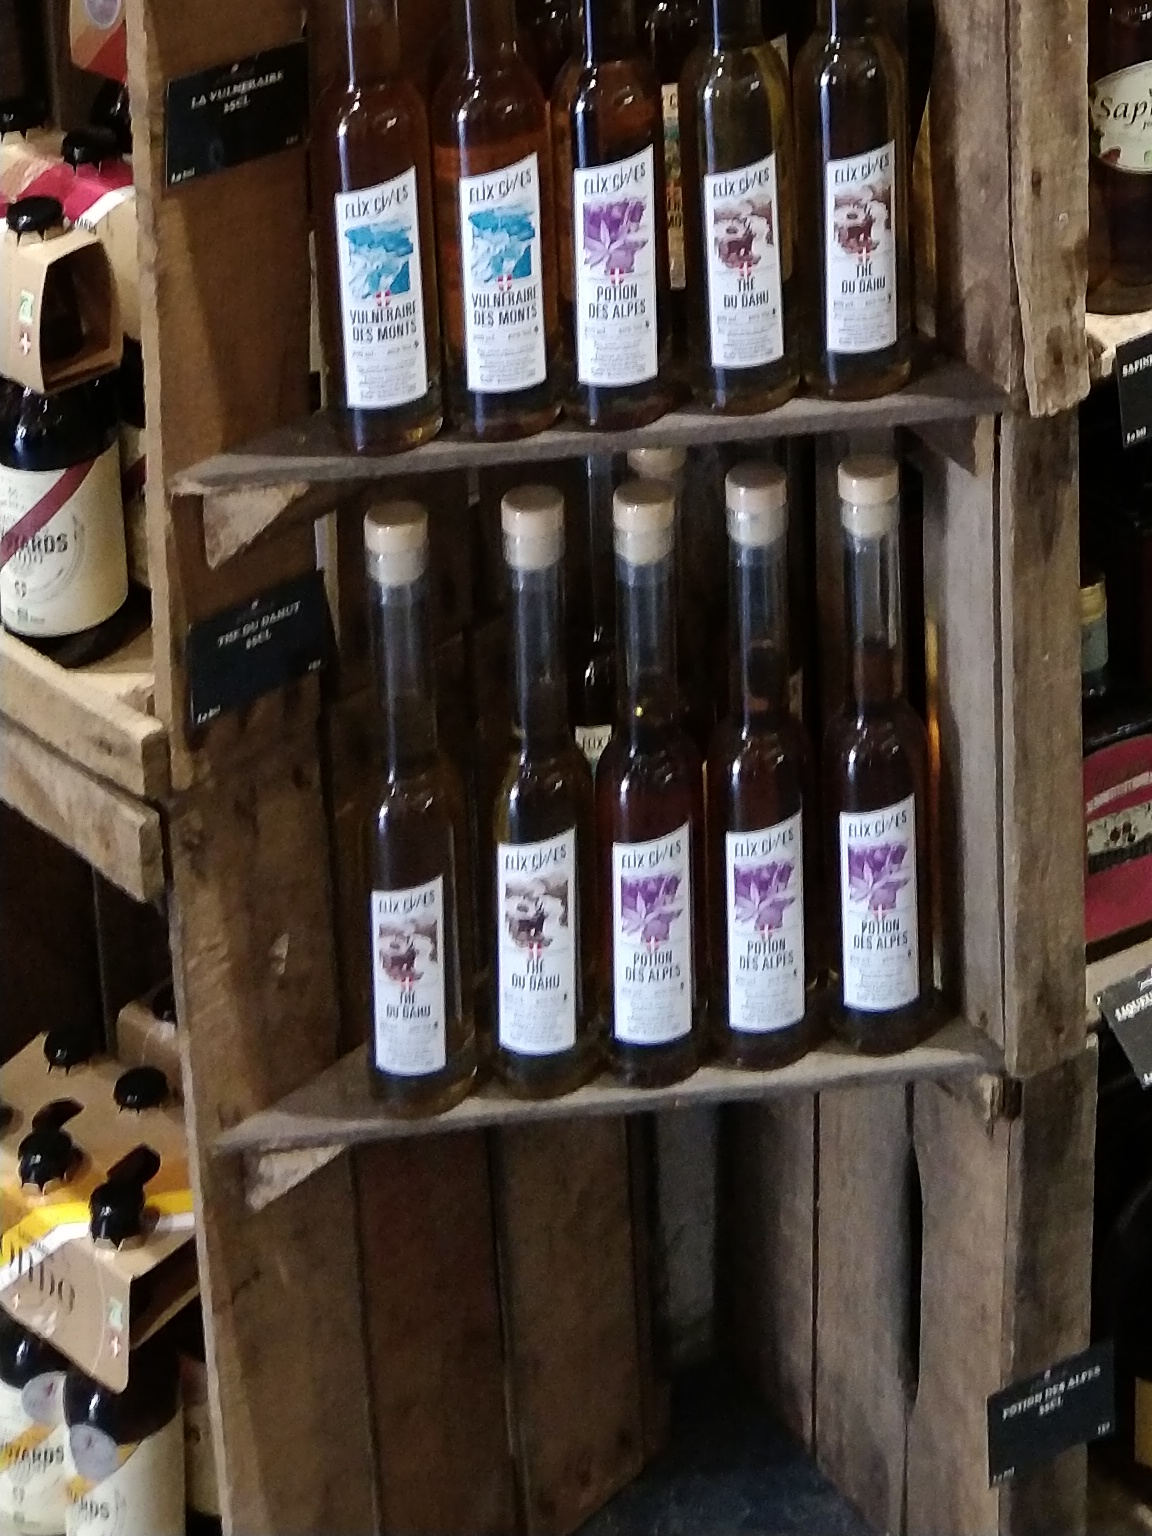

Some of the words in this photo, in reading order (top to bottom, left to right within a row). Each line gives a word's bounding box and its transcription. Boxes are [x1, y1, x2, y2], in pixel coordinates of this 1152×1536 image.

[190, 94, 207, 109] LA
[209, 70, 284, 101] VULNERAIRE
[596, 283, 638, 303] POTION
[841, 279, 856, 294] DU
[858, 275, 887, 293] DAHU
[588, 303, 611, 319] DES
[612, 298, 646, 319] ALPES
[723, 294, 739, 309] DU
[741, 290, 770, 308] DAHU
[473, 308, 495, 326] DES
[498, 302, 538, 325] MONTS
[352, 326, 374, 344] DES
[377, 319, 418, 342] MONTS
[861, 918, 900, 934] POTION
[747, 938, 787, 956] POTION
[853, 934, 873, 950] DES
[876, 930, 908, 950] ALPES
[632, 950, 674, 967] POTION
[738, 955, 759, 971] DES
[761, 949, 794, 972] ALPES
[511, 975, 526, 990] DU
[529, 972, 560, 992] DAHU
[624, 967, 645, 984] DES
[647, 964, 682, 984] ALPES
[385, 1005, 400, 1020] DU
[401, 1003, 432, 1019] DAHU
[1002, 1390, 1043, 1421] POTION
[1044, 1383, 1065, 1401] DES
[1067, 1365, 1101, 1391] ALPES
